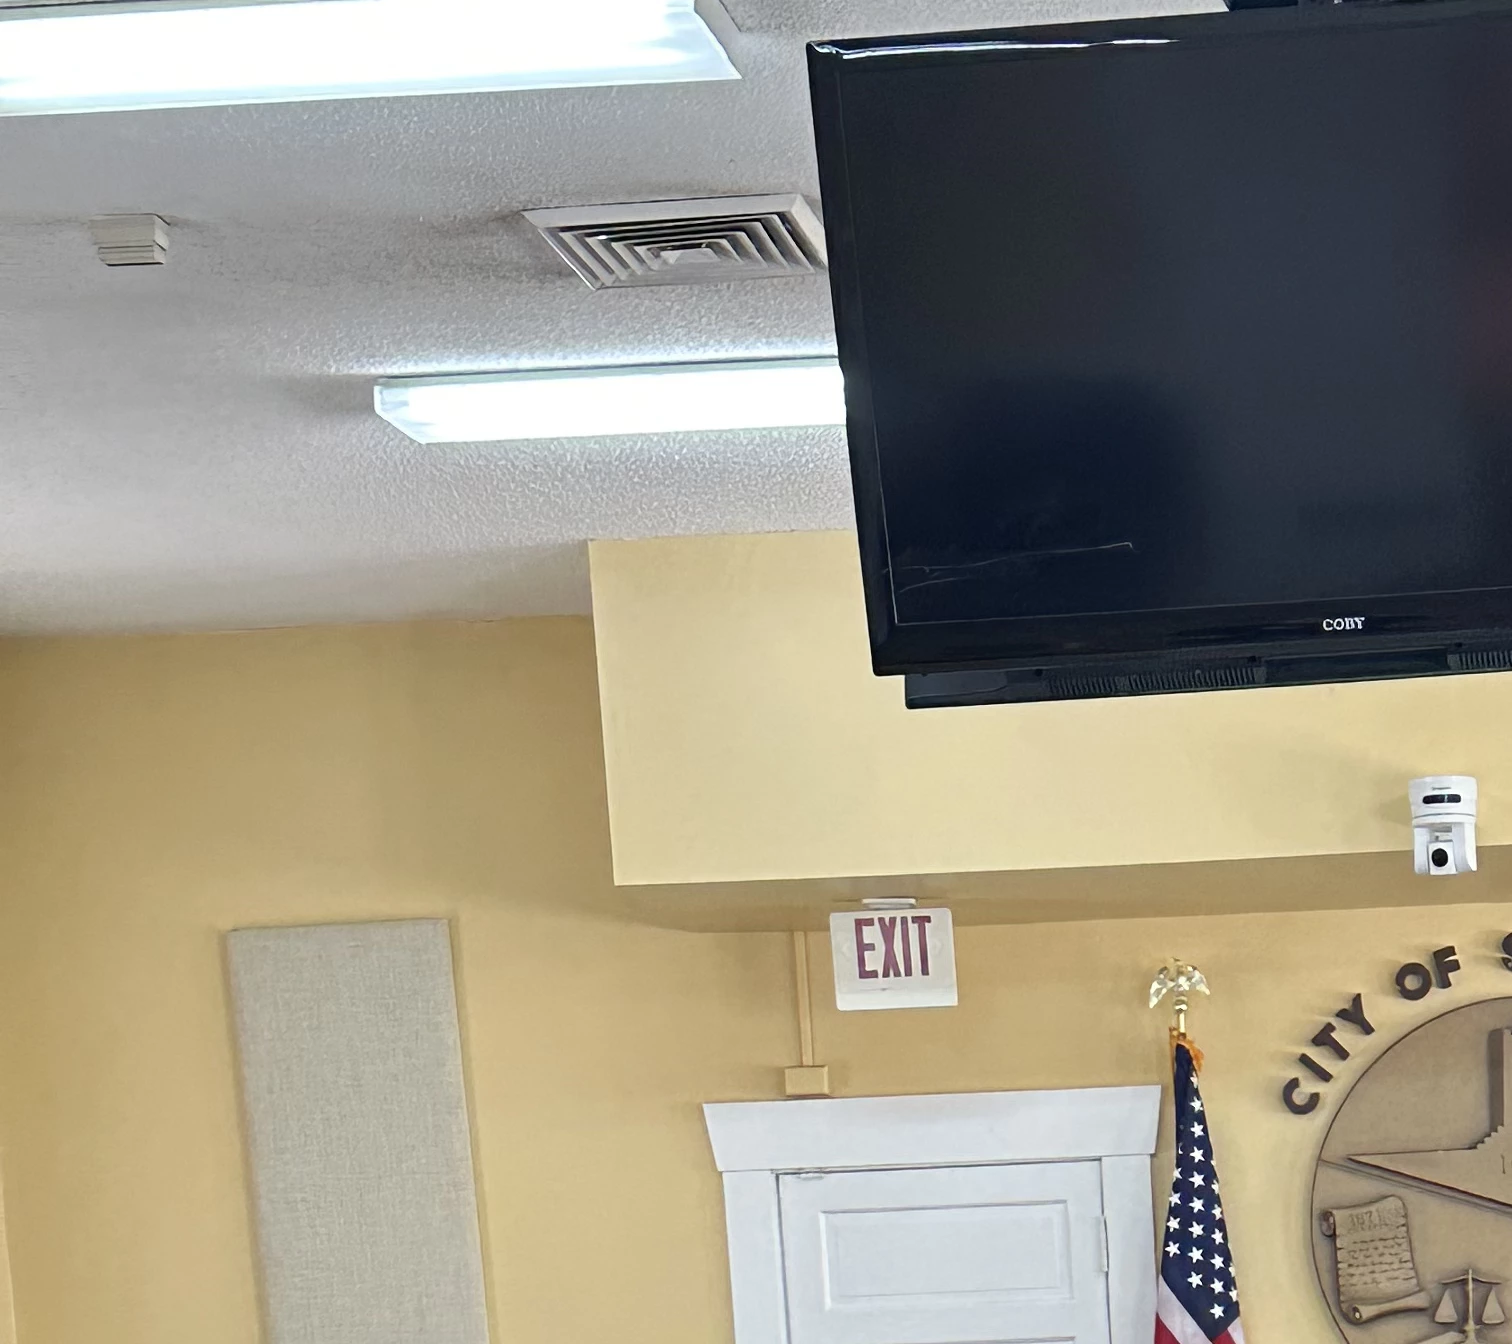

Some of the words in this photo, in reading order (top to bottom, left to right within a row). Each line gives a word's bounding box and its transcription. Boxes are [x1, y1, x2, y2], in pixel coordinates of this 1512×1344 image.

[1322, 617, 1365, 631] COBY
[853, 915, 932, 979] EXIT
[1282, 993, 1376, 1115] CITY
[1395, 945, 1461, 1001] OF
